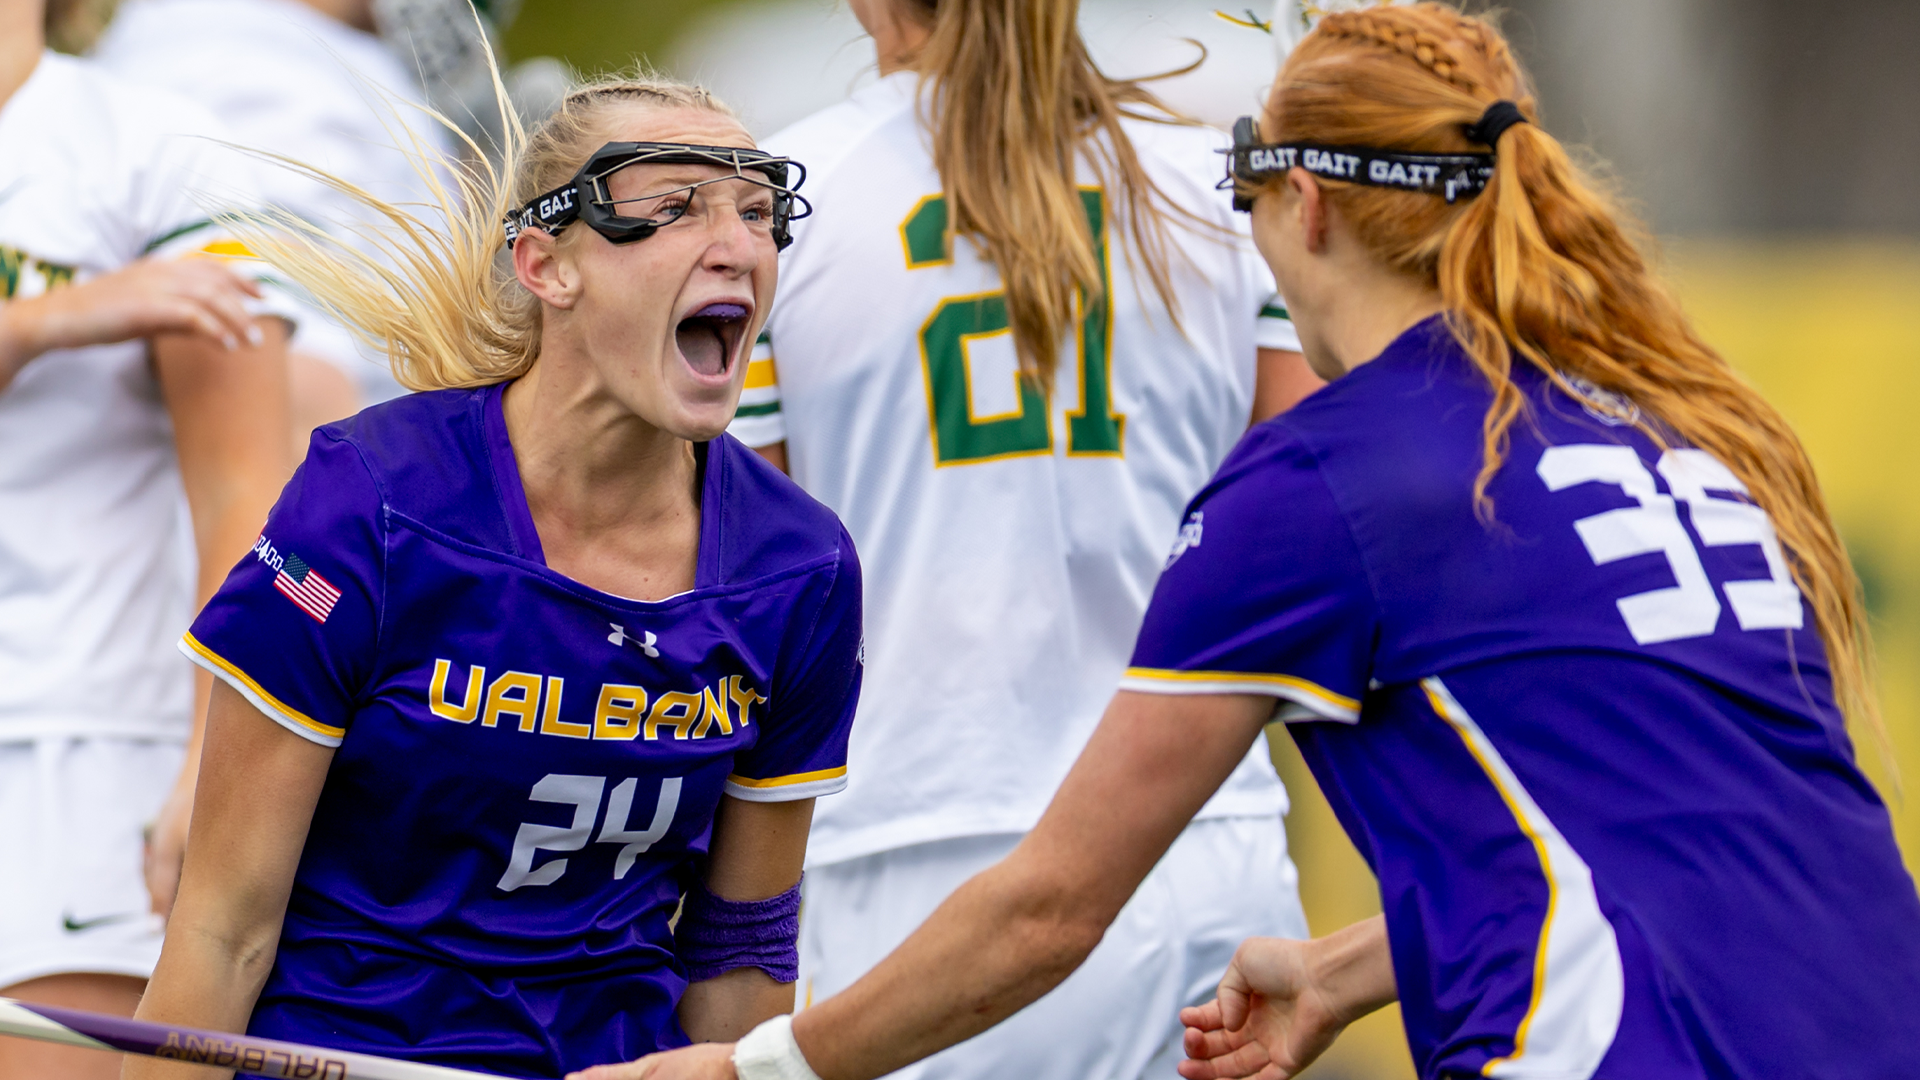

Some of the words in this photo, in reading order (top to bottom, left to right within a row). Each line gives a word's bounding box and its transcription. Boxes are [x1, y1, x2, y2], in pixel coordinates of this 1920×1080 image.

[1250, 148, 1298, 171] GAIT
[1303, 149, 1361, 177] GAIT
[1368, 159, 1441, 187] GAIT
[898, 184, 1126, 469] 21
[1535, 443, 1804, 646] 35
[428, 658, 767, 741] UALBANY
[496, 773, 683, 892] 24
